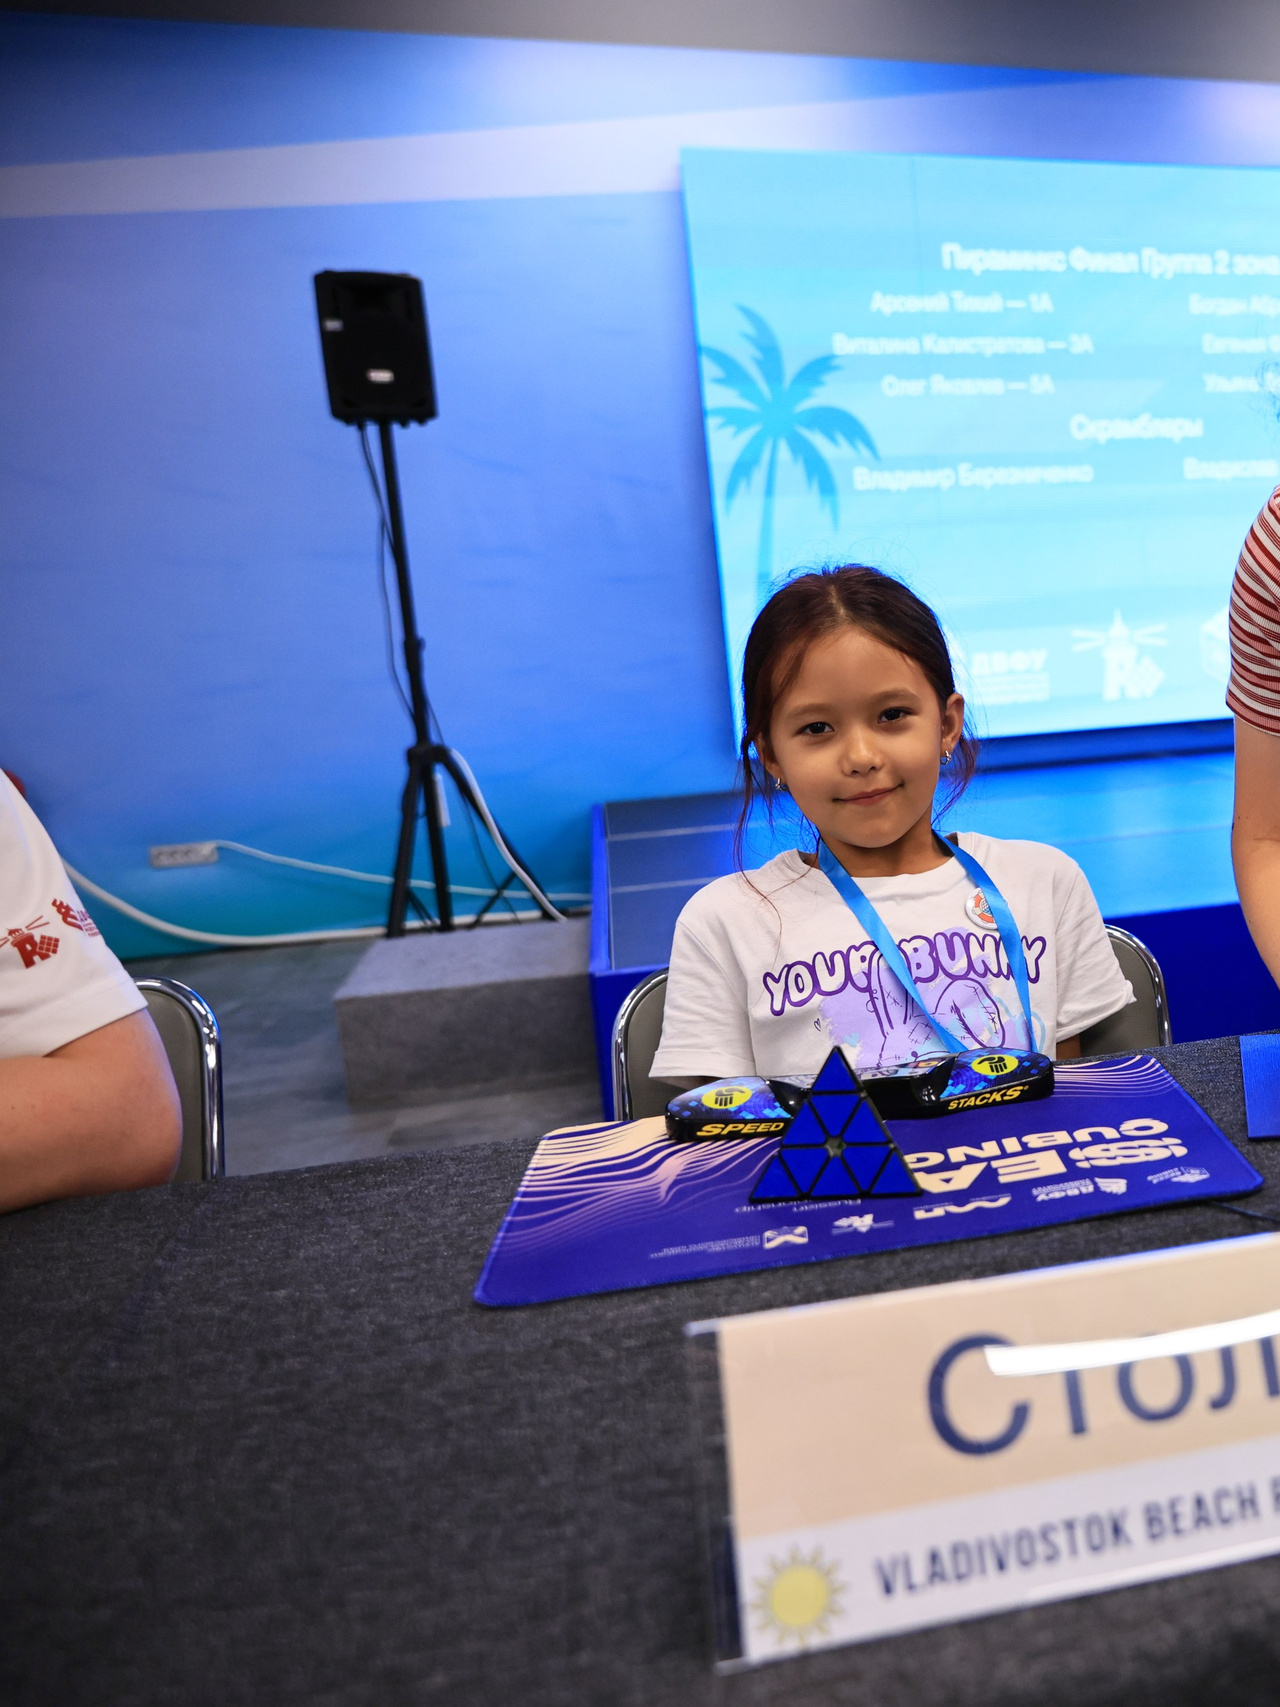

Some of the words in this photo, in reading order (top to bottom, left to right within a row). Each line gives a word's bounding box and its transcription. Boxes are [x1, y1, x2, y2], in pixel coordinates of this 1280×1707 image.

[1068, 246, 1139, 274] Финал
[1141, 247, 1213, 279] Группа
[1214, 248, 1230, 275] 2
[1232, 254, 1280, 276] зона
[697, 1121, 784, 1137] SPEED
[904, 1118, 1169, 1169] CUBING
[914, 1137, 1188, 1194] SEA
[874, 1505, 1133, 1597] VLADIVOSTOK
[1144, 1482, 1262, 1542] BEACH
